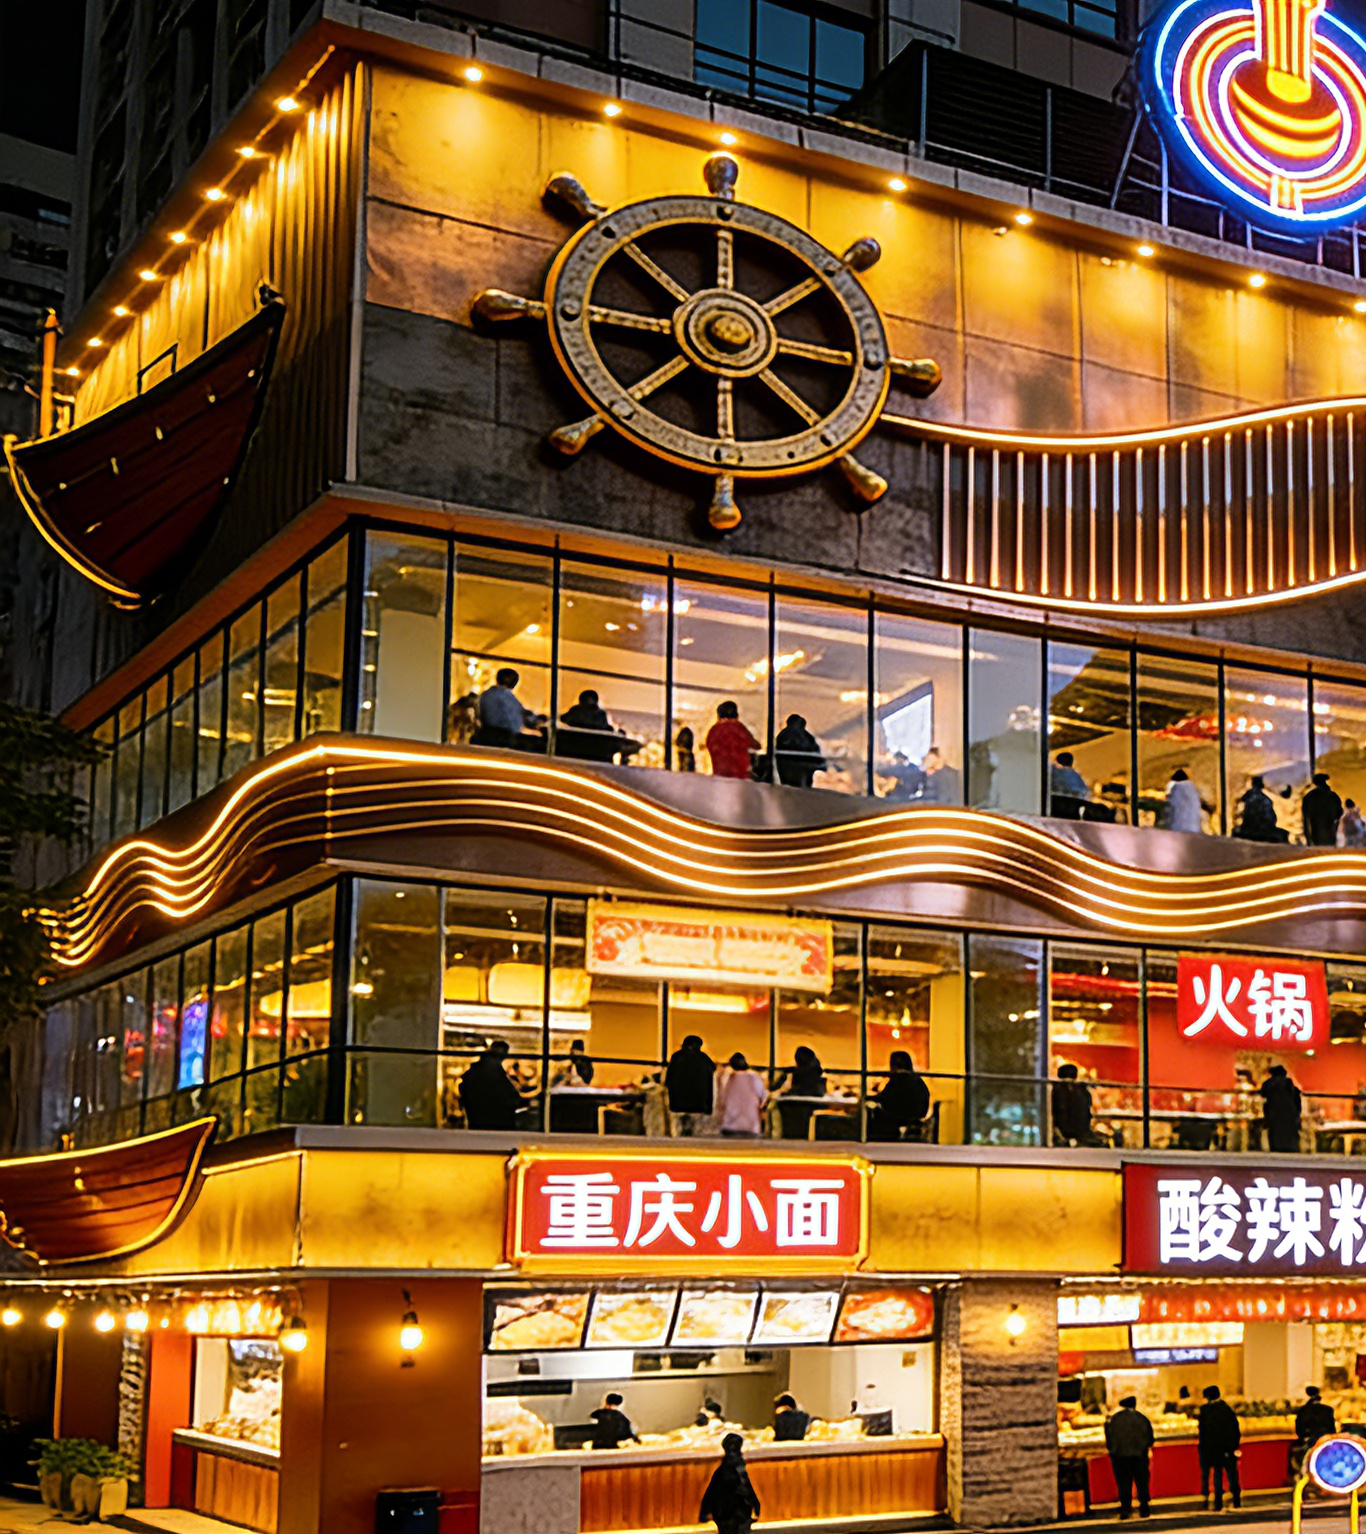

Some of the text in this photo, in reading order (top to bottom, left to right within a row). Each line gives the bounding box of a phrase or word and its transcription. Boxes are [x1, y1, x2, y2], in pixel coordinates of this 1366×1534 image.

[1183, 963, 1313, 1042] 火锅
[539, 1172, 845, 1249] 重庆小面
